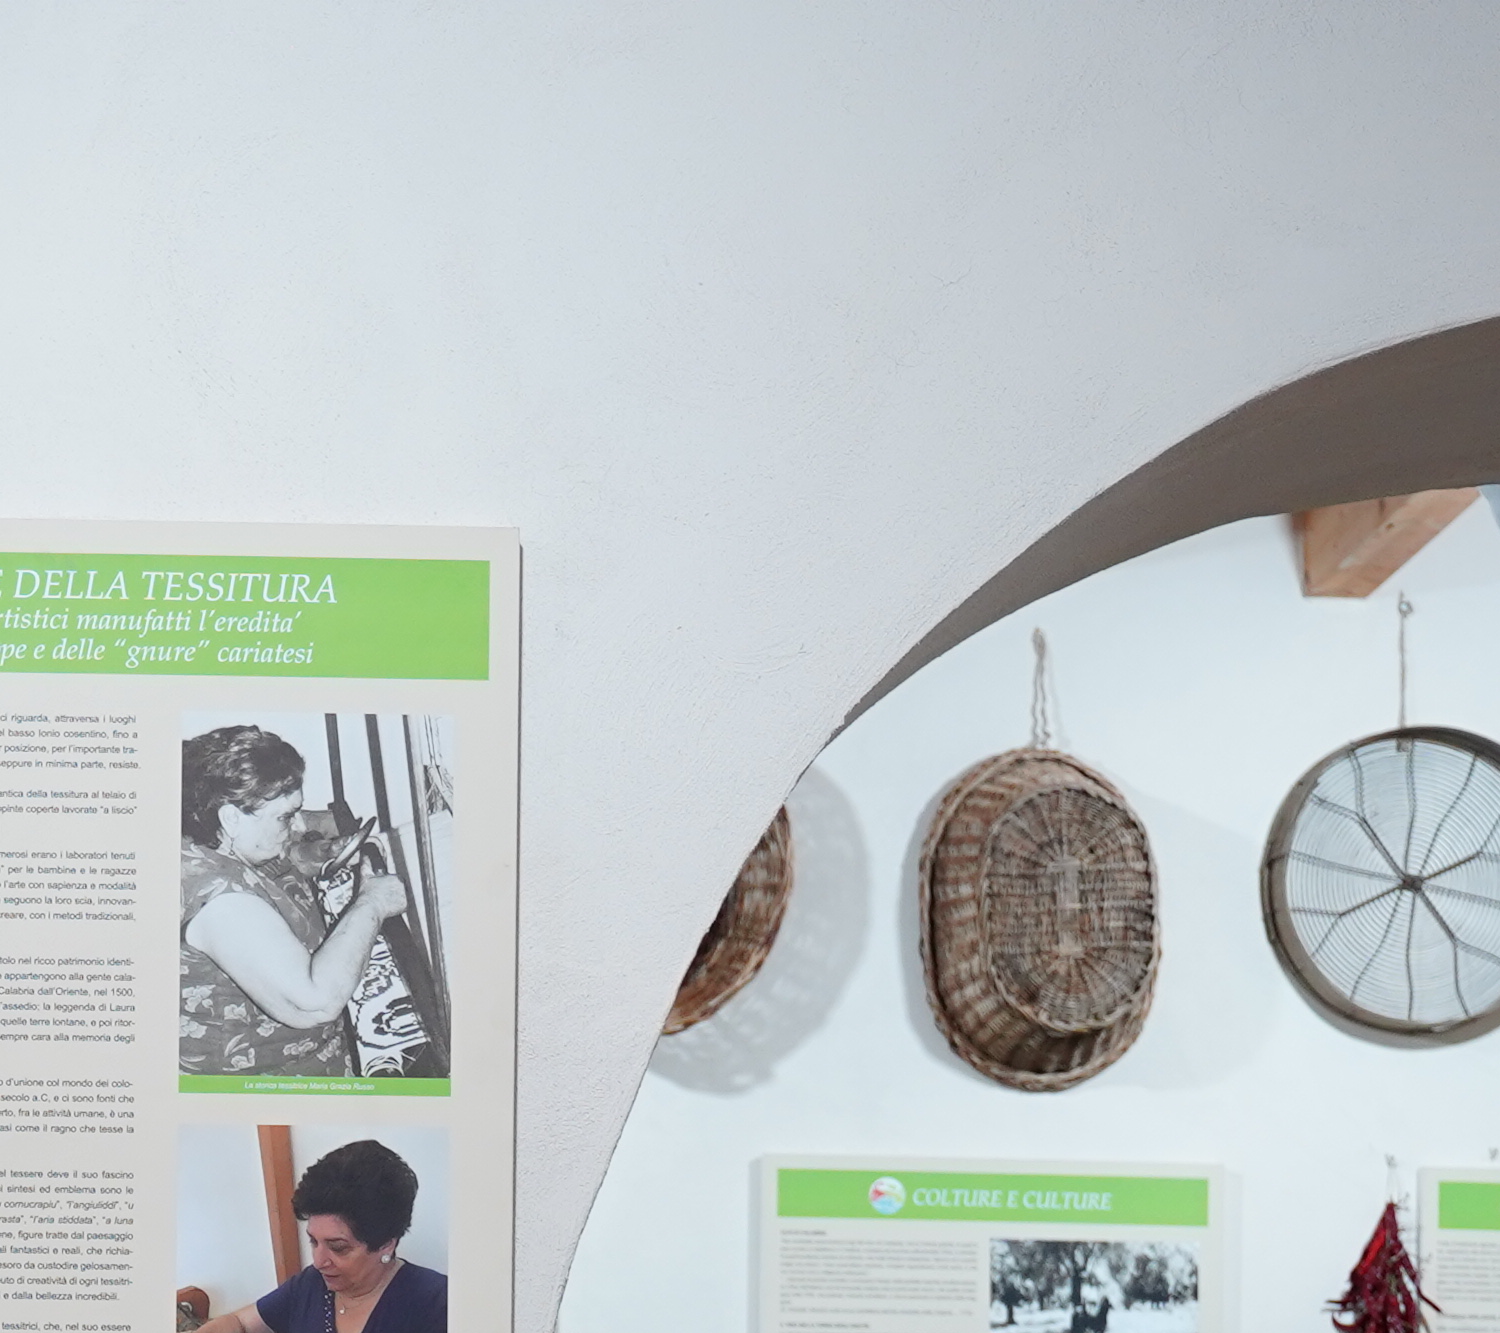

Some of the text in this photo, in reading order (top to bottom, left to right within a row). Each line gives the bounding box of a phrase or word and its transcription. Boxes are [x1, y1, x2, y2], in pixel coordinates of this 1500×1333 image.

[13, 568, 128, 600] DELLA
[141, 570, 336, 603] TESSITURA
[76, 607, 191, 638] manufatti
[33, 643, 45, 659] e
[51, 637, 105, 660] delle
[114, 635, 210, 668] "gnure"
[217, 640, 313, 664] cariatesi
[912, 1187, 1112, 1211] COLTURE E CULTURE
